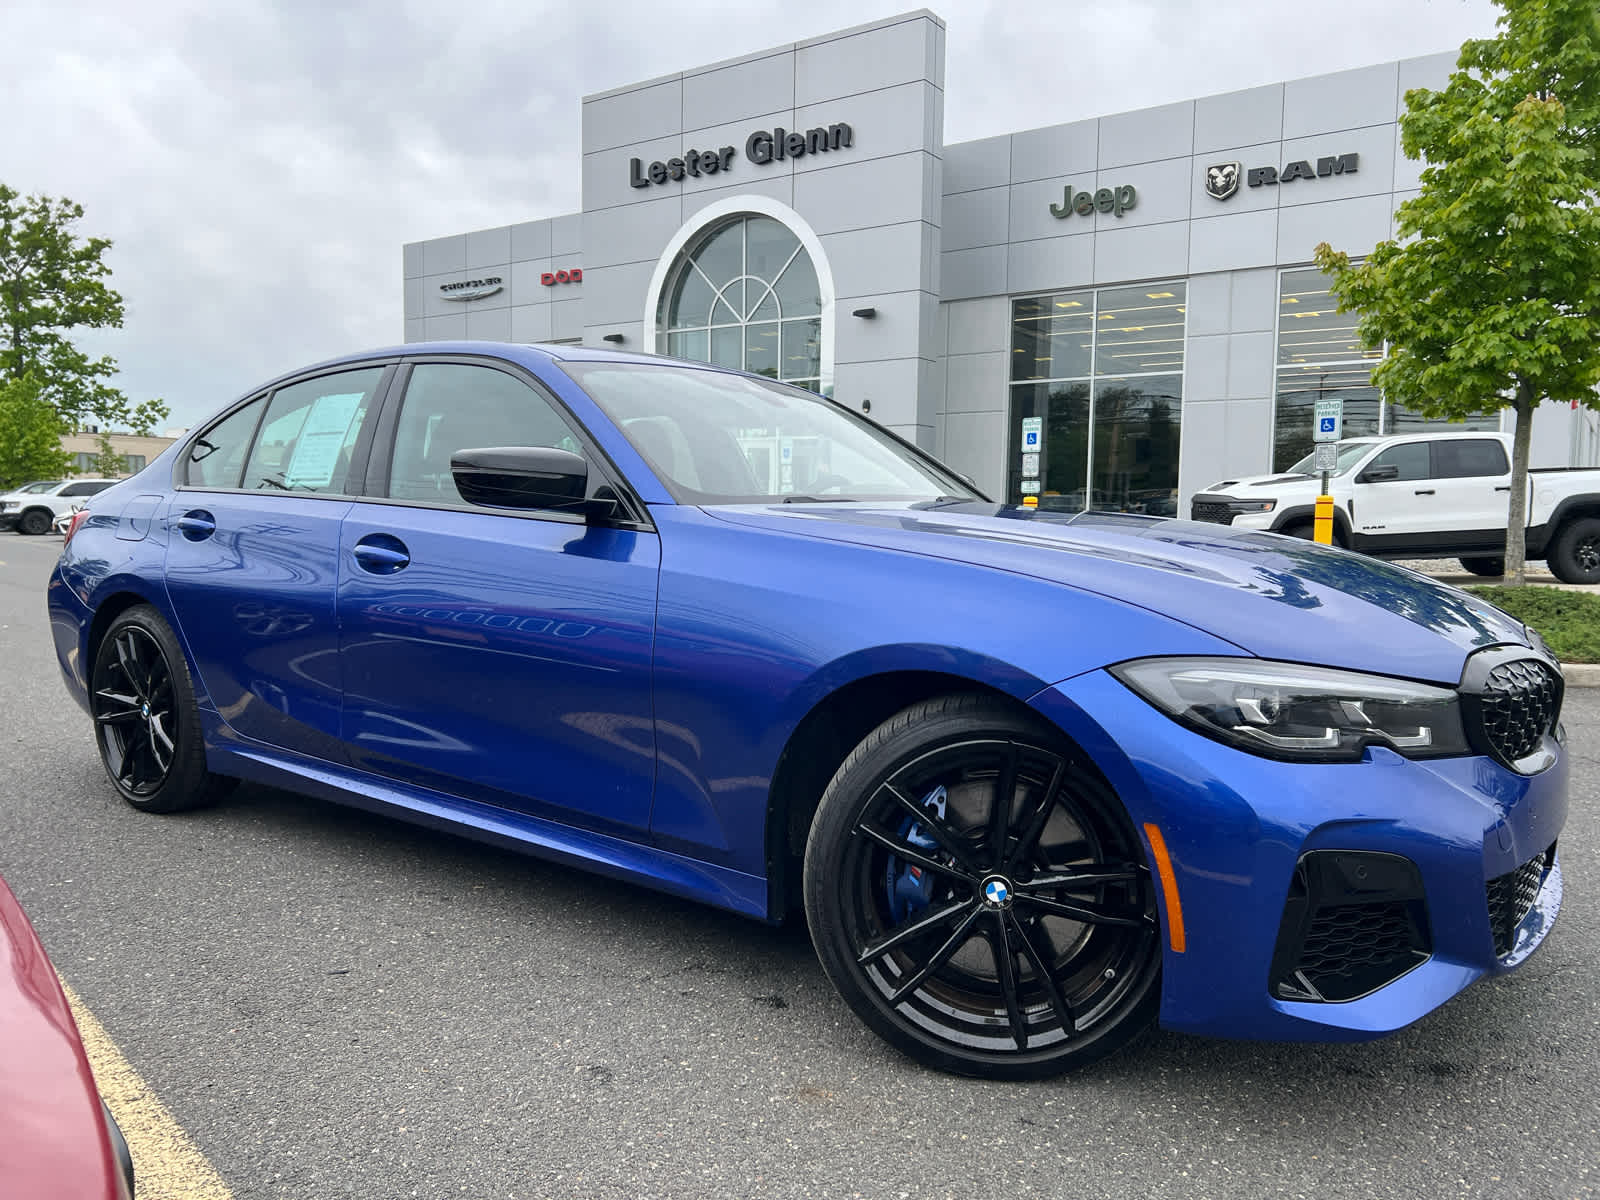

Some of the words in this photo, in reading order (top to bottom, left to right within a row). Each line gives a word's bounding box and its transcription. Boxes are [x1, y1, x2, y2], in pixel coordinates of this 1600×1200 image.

[630, 143, 735, 189] Lester
[745, 121, 853, 166] Glenn
[1247, 152, 1359, 187] RAM
[1050, 184, 1137, 219] Jeep
[440, 276, 503, 292] CHRYSLER
